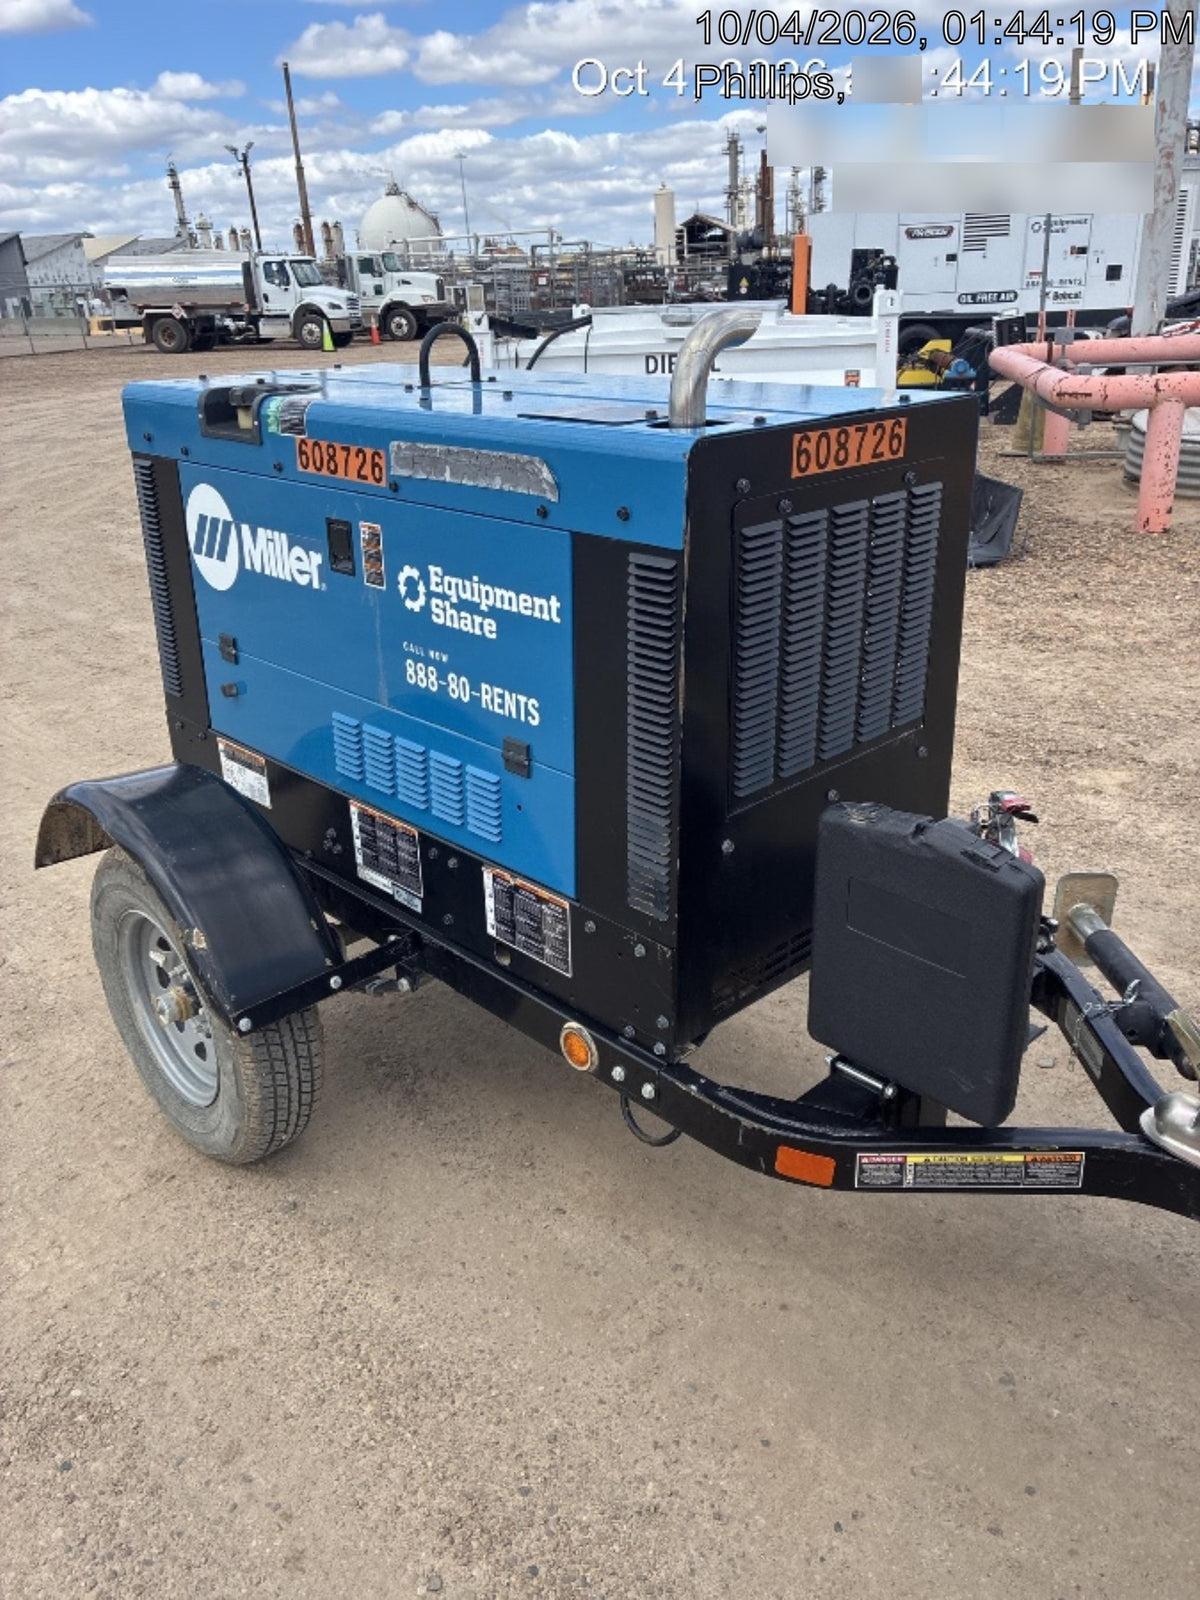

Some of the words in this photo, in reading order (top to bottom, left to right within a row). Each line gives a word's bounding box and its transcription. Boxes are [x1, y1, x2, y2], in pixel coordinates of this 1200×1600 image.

[645, 353, 721, 374] DIEL
[298, 439, 383, 484] 608726
[796, 419, 902, 473] 608726
[241, 524, 323, 589] Miller
[428, 565, 561, 624] Equipment
[431, 597, 497, 639] Share
[406, 659, 541, 726] 888-80-RENTS
